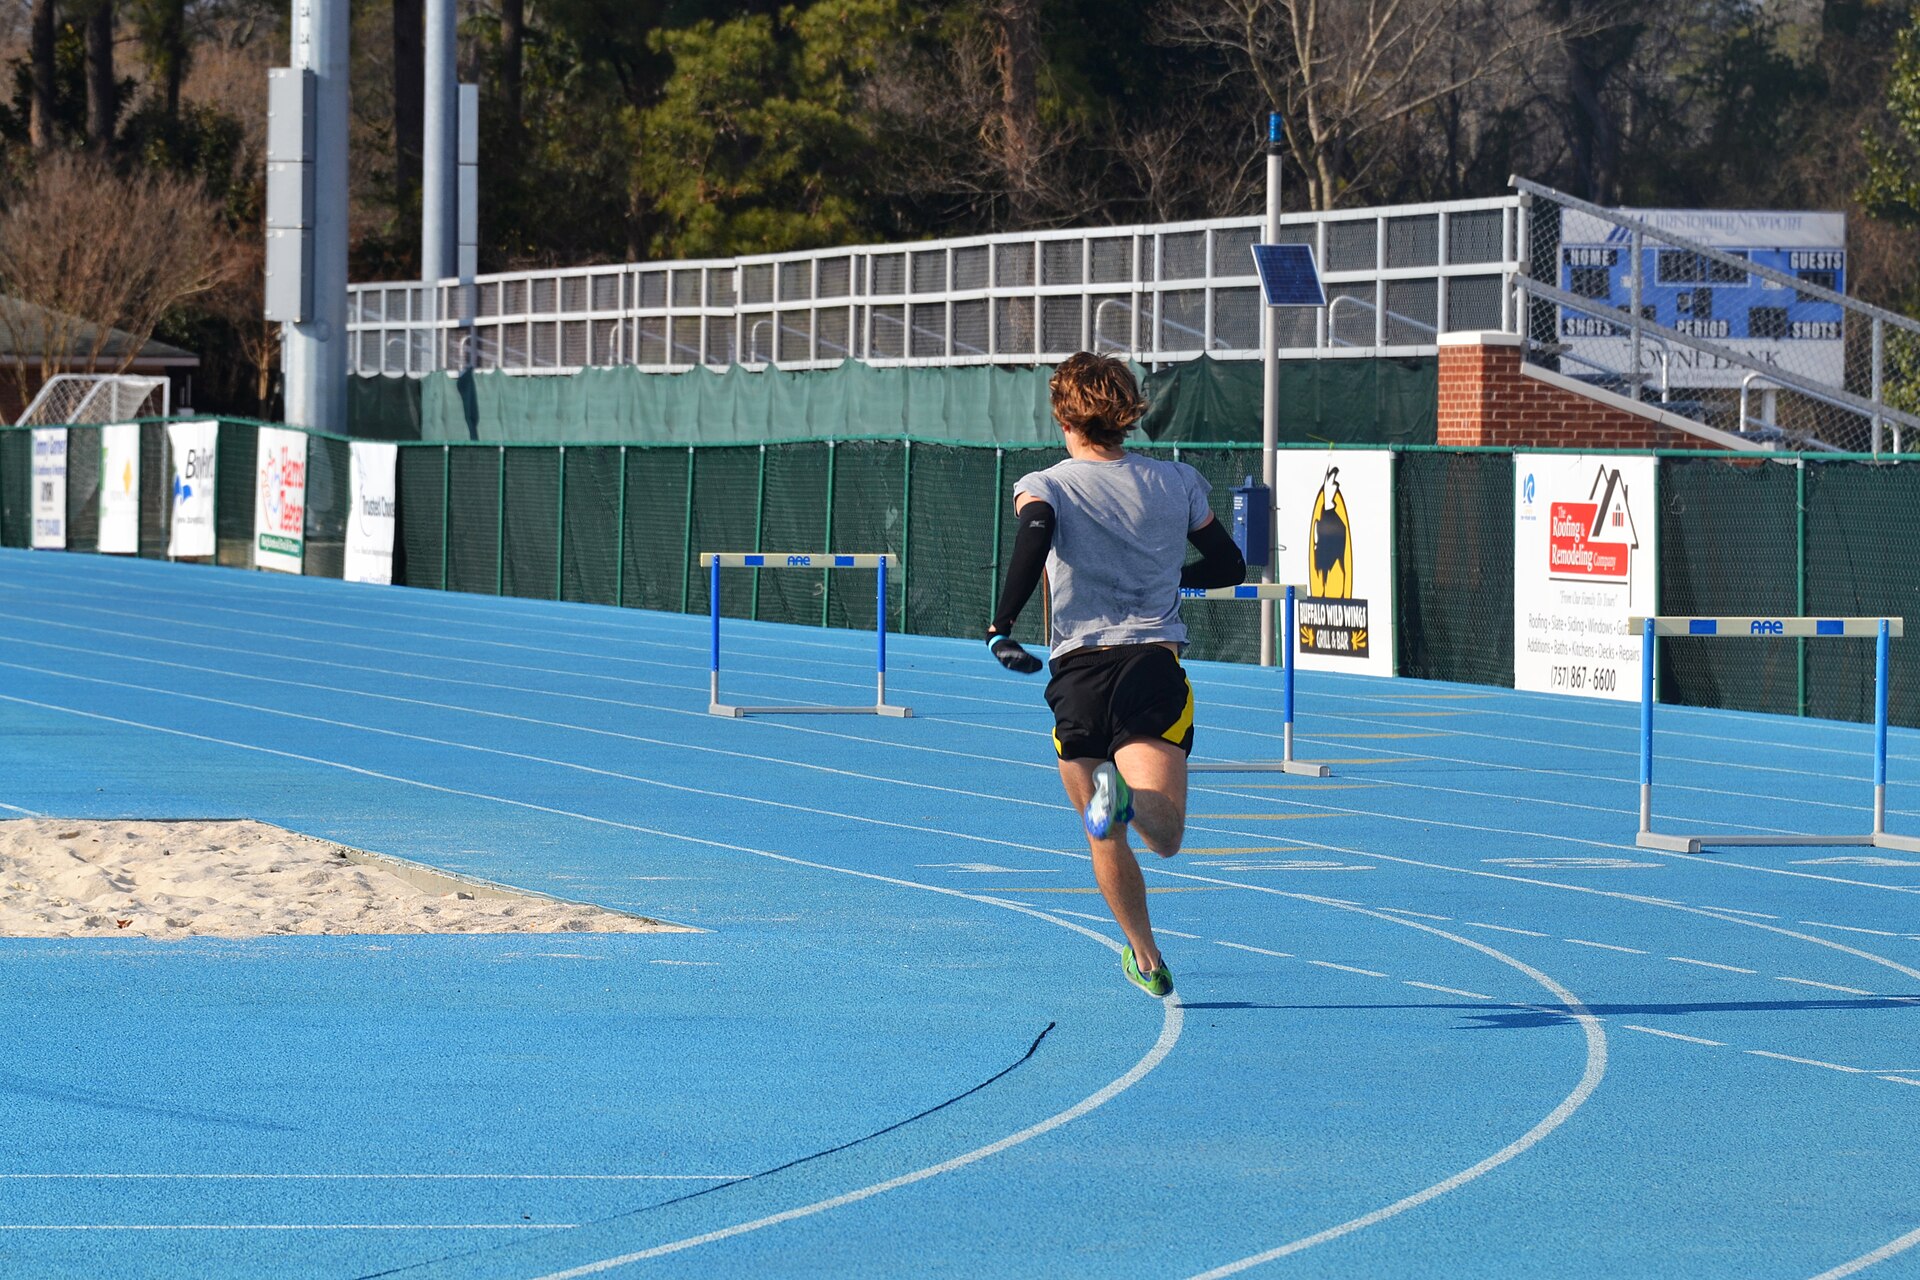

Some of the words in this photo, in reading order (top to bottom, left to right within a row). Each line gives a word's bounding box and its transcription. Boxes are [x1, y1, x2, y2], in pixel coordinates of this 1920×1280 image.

[1738, 214, 1803, 232] NEWPORT
[1571, 250, 1610, 266] HOME
[1790, 252, 1842, 270] GUESTS
[1566, 319, 1612, 336] SHOTS
[1677, 320, 1728, 337] PERIOD
[1791, 323, 1838, 338] SHOTS
[281, 446, 305, 488] Harris
[362, 495, 381, 516] Trusted
[1558, 506, 1566, 519] The
[1552, 515, 1581, 543] Roofing
[1580, 523, 1585, 537] &
[1552, 544, 1593, 572] Remodeling
[1593, 553, 1616, 571] Company
[1581, 591, 1596, 609] Family
[1300, 603, 1326, 626] BUFFALO
[1326, 604, 1343, 626] WILD
[1344, 605, 1366, 628] WINGS
[1528, 613, 1548, 634] Roofing
[1551, 615, 1563, 631] Slate
[1568, 616, 1584, 637] Siding
[1588, 618, 1613, 635] Windows
[1316, 630, 1331, 649] GRILL
[1331, 630, 1336, 649] &
[1336, 631, 1349, 650] BAR
[1527, 638, 1550, 654] Additions
[1554, 639, 1568, 656] Baths
[1572, 641, 1594, 658] Kitchens
[1598, 643, 1615, 659] Decks
[1619, 645, 1640, 664] Repairs
[1551, 665, 1569, 689] (757)
[1570, 666, 1587, 688] 867
[1593, 667, 1616, 692] 6600
